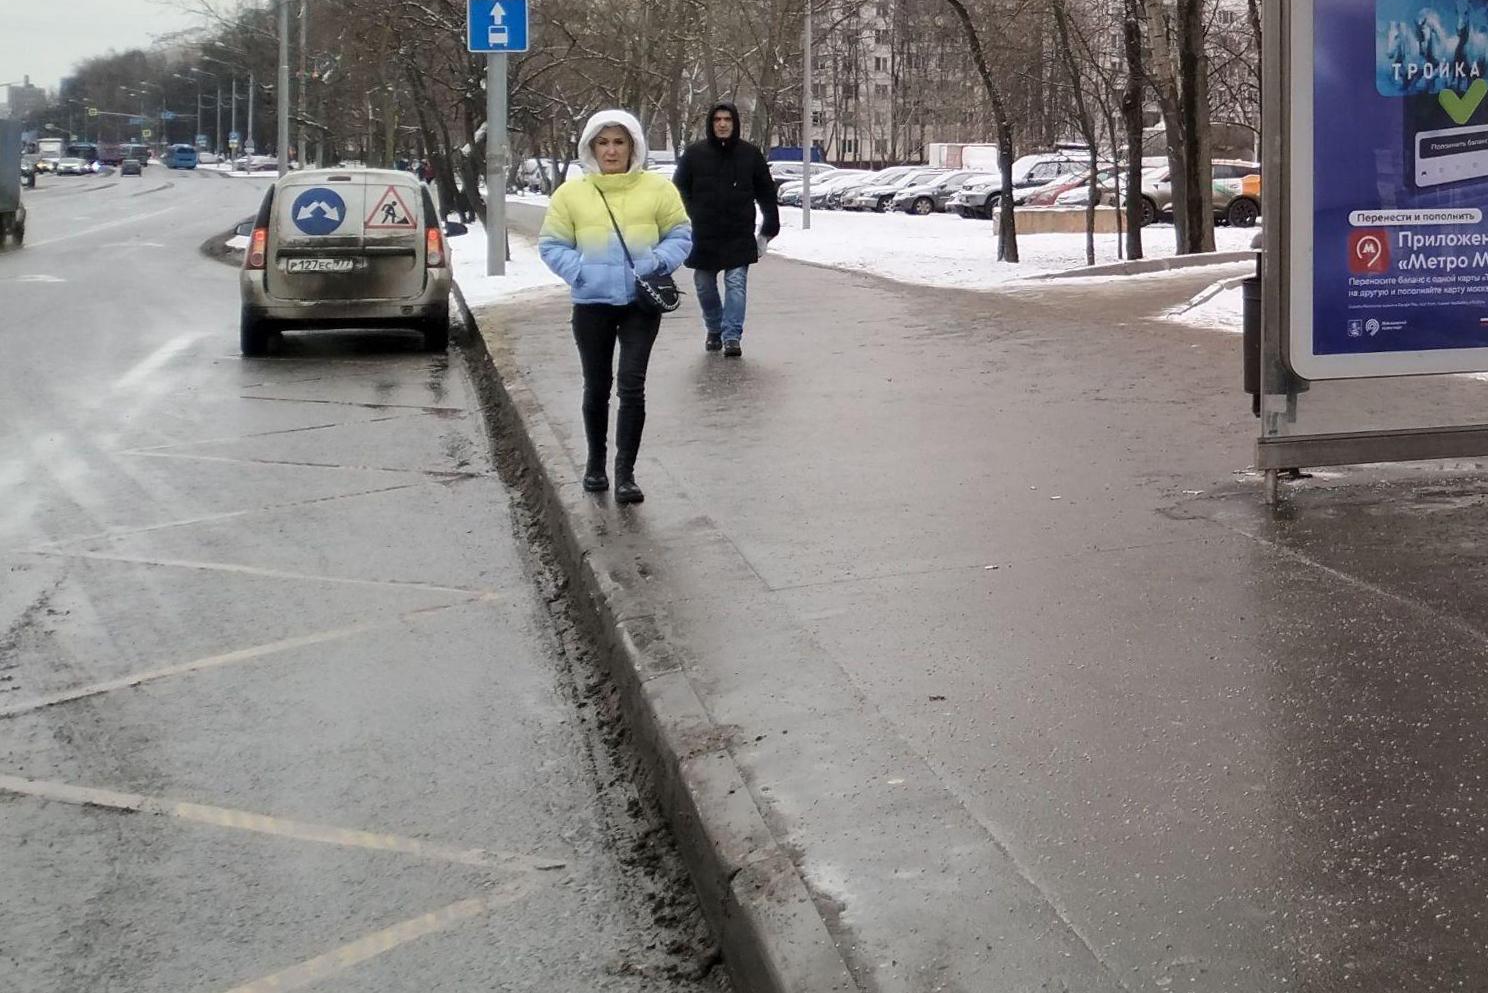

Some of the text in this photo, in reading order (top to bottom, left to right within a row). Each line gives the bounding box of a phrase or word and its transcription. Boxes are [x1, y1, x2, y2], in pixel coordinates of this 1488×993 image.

[1391, 61, 1481, 80] ТРОЙКА
[1357, 213, 1412, 224] Перенести
[1422, 211, 1475, 221] пополнить
[1398, 253, 1468, 272] «Метро
